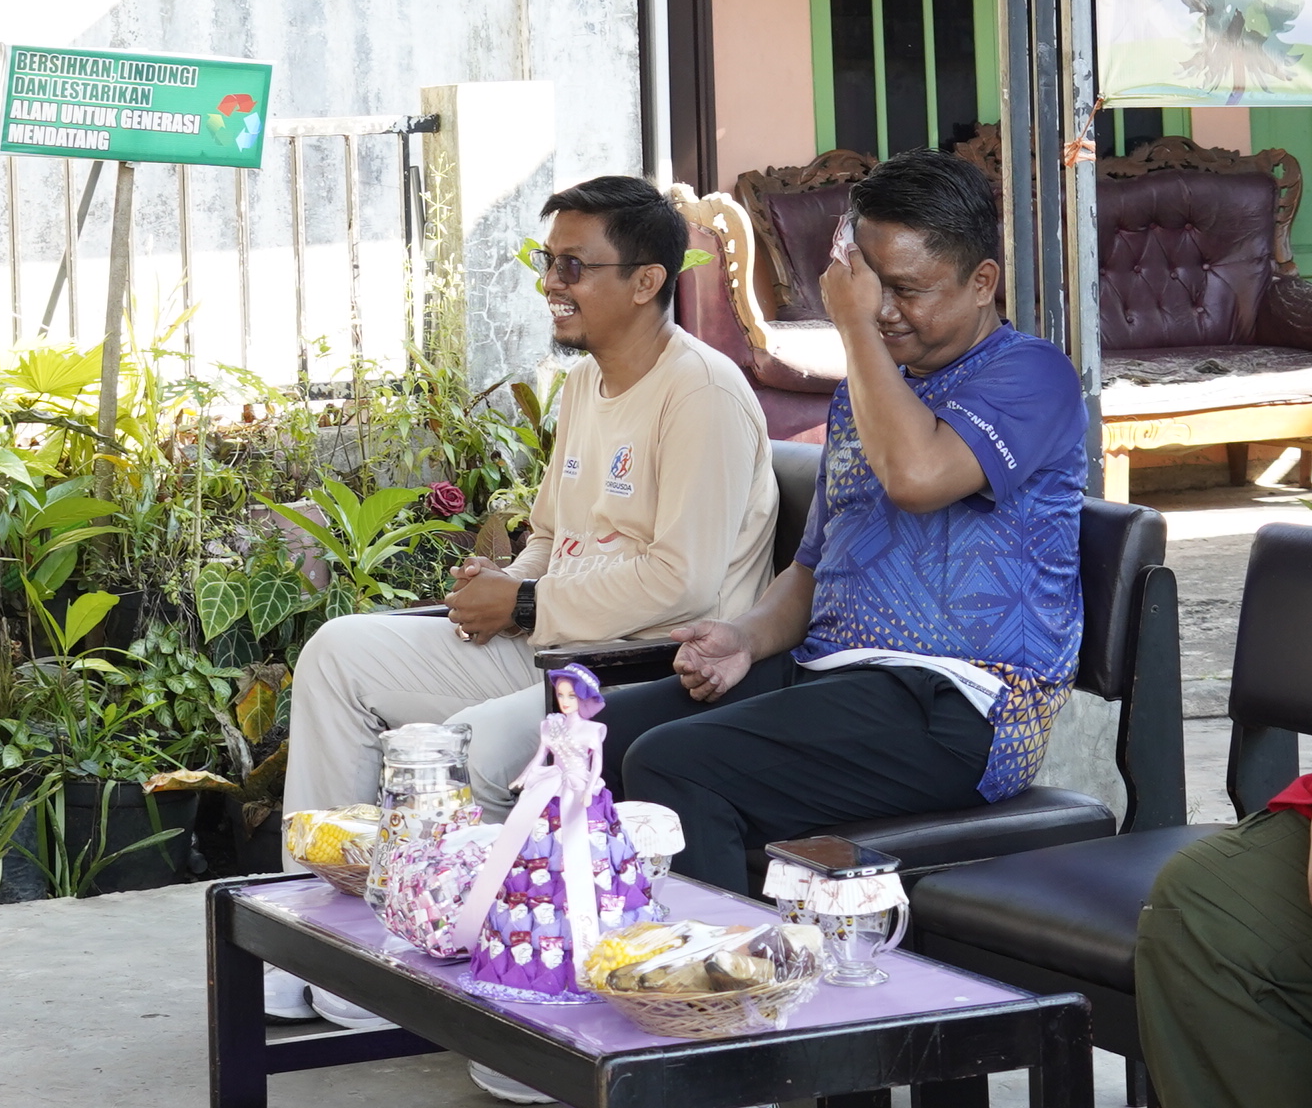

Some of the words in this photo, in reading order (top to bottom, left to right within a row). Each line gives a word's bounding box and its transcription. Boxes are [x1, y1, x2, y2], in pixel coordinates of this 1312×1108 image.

[16, 52, 116, 82] BERSIHKAN,
[119, 62, 198, 86] LINDUNGI
[14, 76, 48, 97] DAN
[51, 78, 152, 106] LESTARIKAN
[10, 99, 57, 123] ALAM
[60, 104, 117, 128] UNTUK
[120, 109, 200, 134] GENERASI
[7, 123, 110, 151] MENDATANG
[995, 440, 1017, 469] SATU
